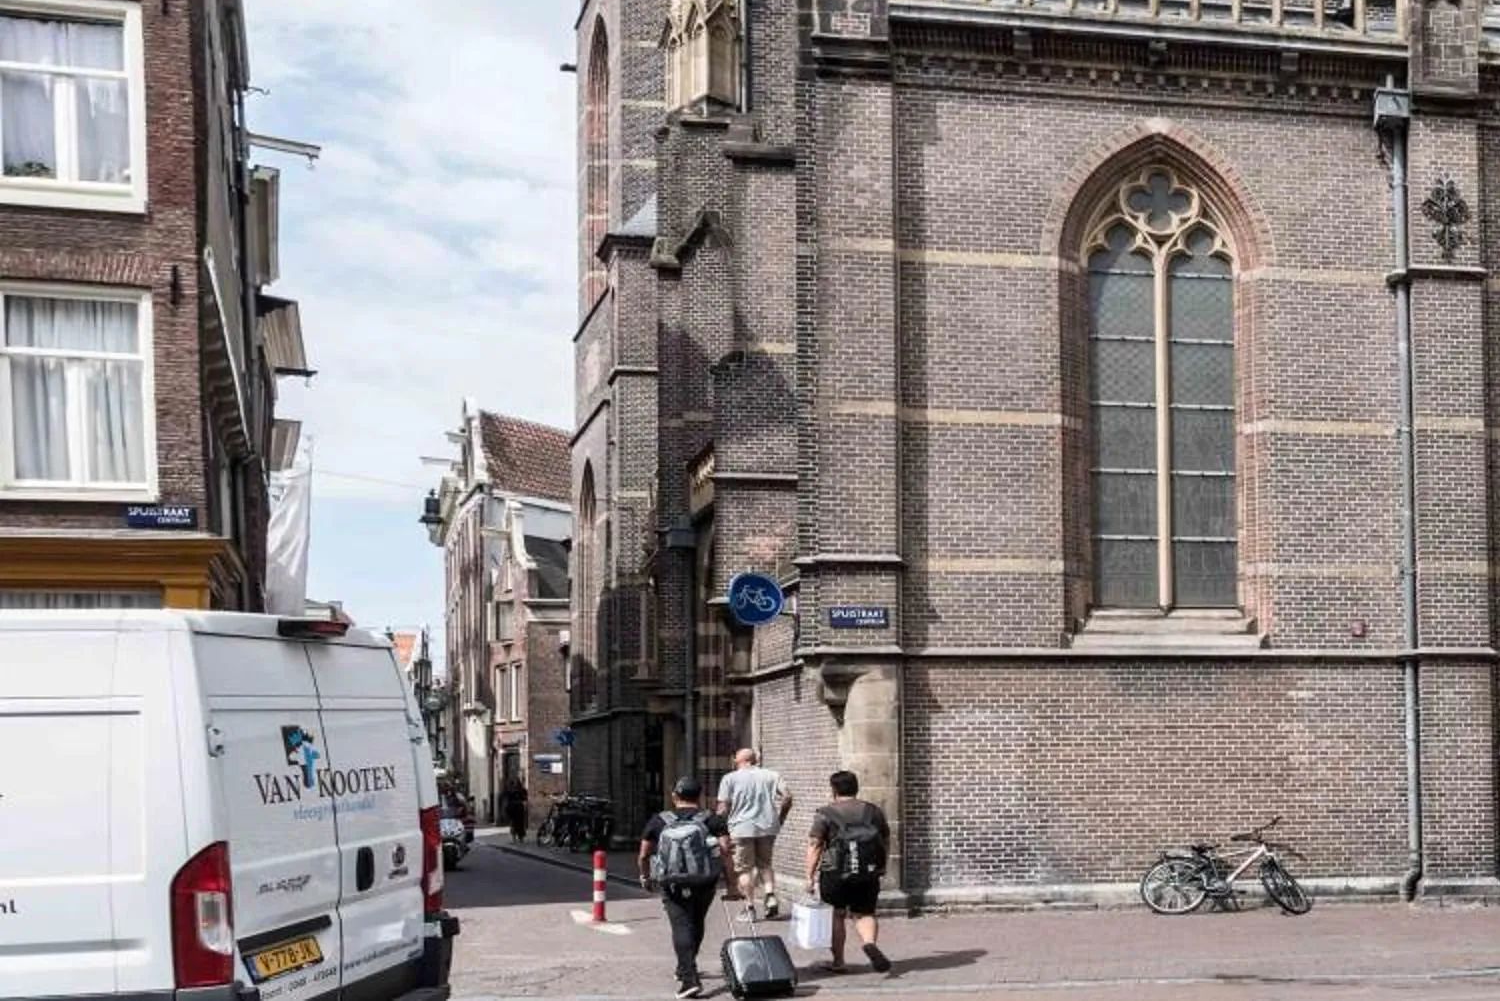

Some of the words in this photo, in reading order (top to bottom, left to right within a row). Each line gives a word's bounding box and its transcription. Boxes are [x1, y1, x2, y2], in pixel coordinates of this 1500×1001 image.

[127, 506, 190, 517] SPUISTRAAT
[831, 609, 884, 618] SPUISTRAAT
[253, 773, 301, 805] VAN
[317, 766, 397, 798] KOOTEN
